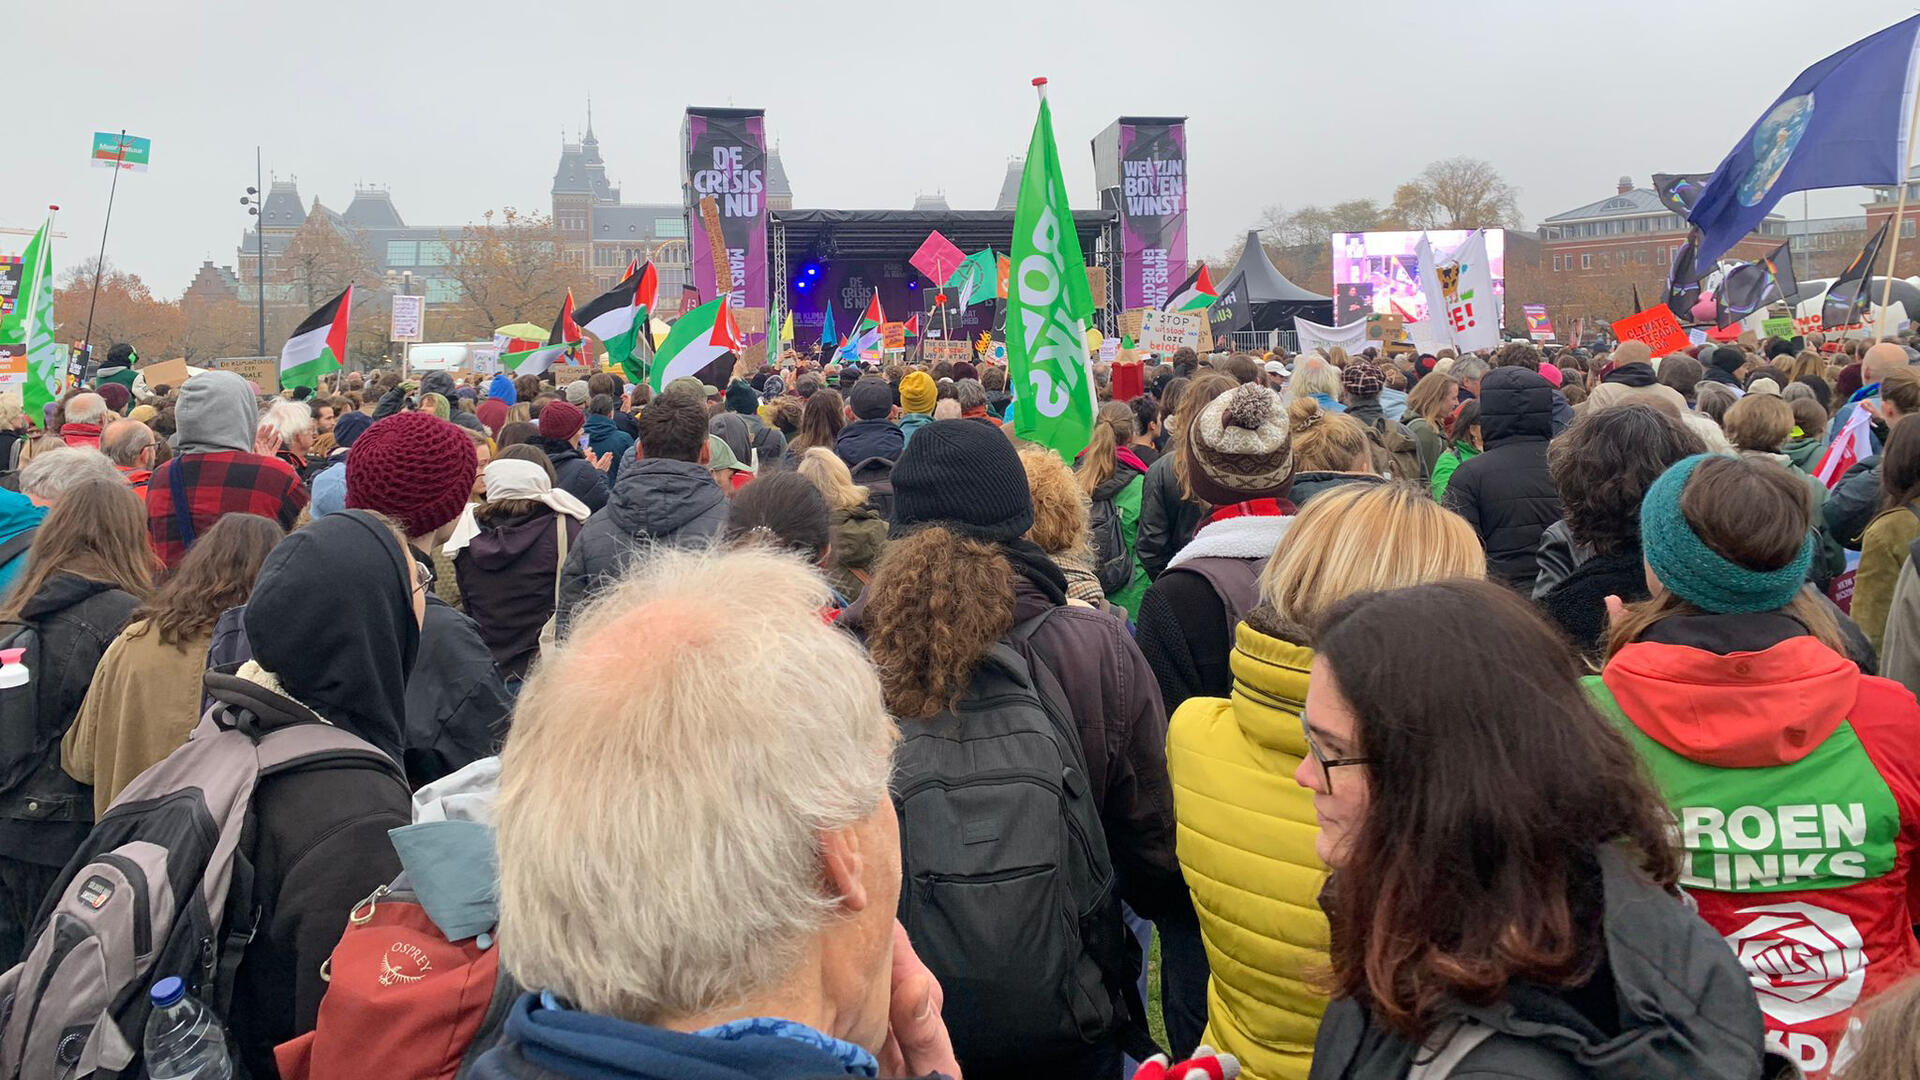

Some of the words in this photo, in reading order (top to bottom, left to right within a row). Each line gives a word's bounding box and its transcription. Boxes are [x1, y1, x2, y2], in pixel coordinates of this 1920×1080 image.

[713, 146, 743, 170] DE
[1123, 157, 1182, 177] WELZIJN
[694, 169, 763, 193] CRISIS
[1125, 176, 1183, 196] BOVEN
[725, 193, 758, 217] NU
[1127, 195, 1181, 216] WINST
[1142, 248, 1155, 265] EN
[1155, 248, 1169, 284] MARS
[728, 248, 745, 289] MARS
[841, 287, 872, 298] CRISIS
[849, 276, 863, 288] DE
[1142, 268, 1156, 306] RECHT
[730, 289, 746, 309] VO
[1155, 286, 1169, 310] VO
[1160, 314, 1190, 326] STOP
[1627, 316, 1669, 339] CLIMATE
[1637, 325, 1679, 345] TIFADA
[1682, 803, 1867, 851] ROEN
[1677, 851, 1867, 891] LINKS
[391, 941, 433, 972] OSPREY
